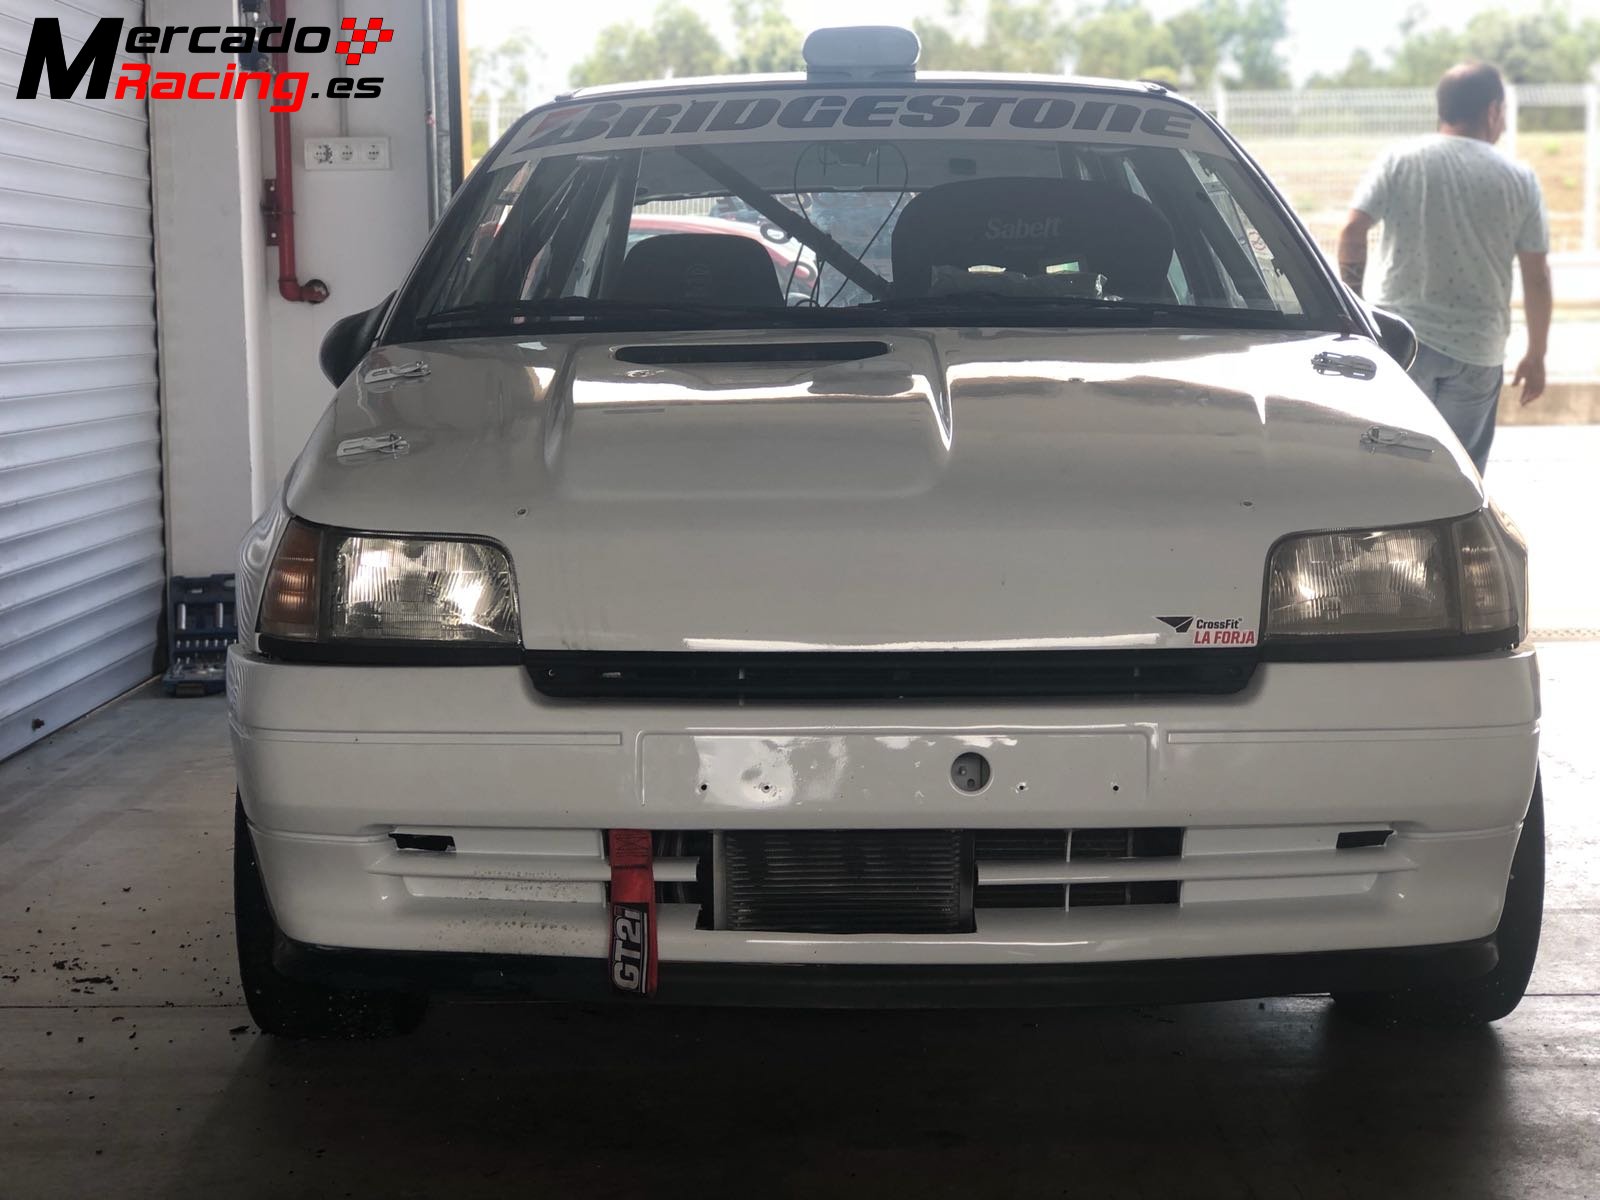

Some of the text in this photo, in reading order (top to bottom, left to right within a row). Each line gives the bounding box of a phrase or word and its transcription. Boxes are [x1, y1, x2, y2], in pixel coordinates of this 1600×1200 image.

[511, 94, 1196, 154] BRIDGESTONE
[984, 216, 1064, 241] Sabelt
[1194, 630, 1255, 645] LA FORJA
[613, 908, 642, 991] GT2i
